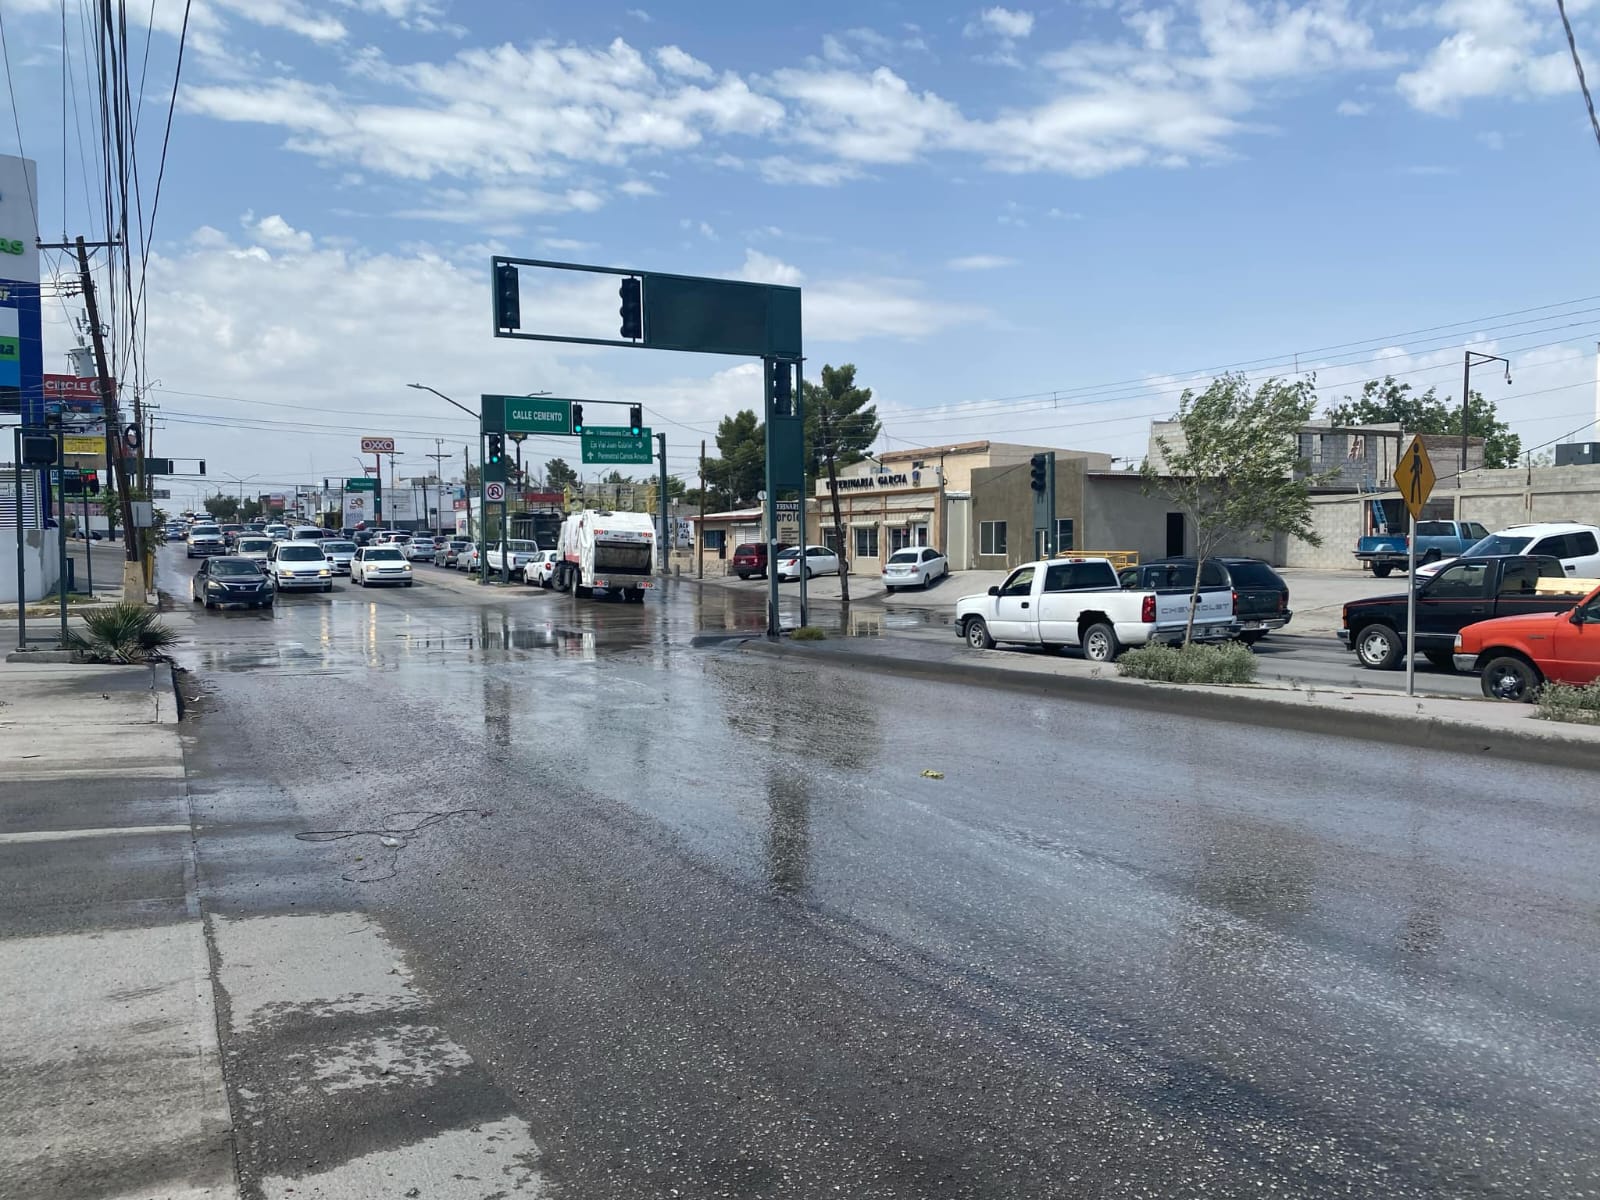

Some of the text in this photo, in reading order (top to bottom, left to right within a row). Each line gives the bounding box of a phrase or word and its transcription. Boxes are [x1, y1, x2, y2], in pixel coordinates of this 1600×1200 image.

[512, 410, 563, 422] CALLE CEMENTO
[363, 441, 393, 450] OXXO
[826, 473, 908, 490] VERINARIA GARCIA
